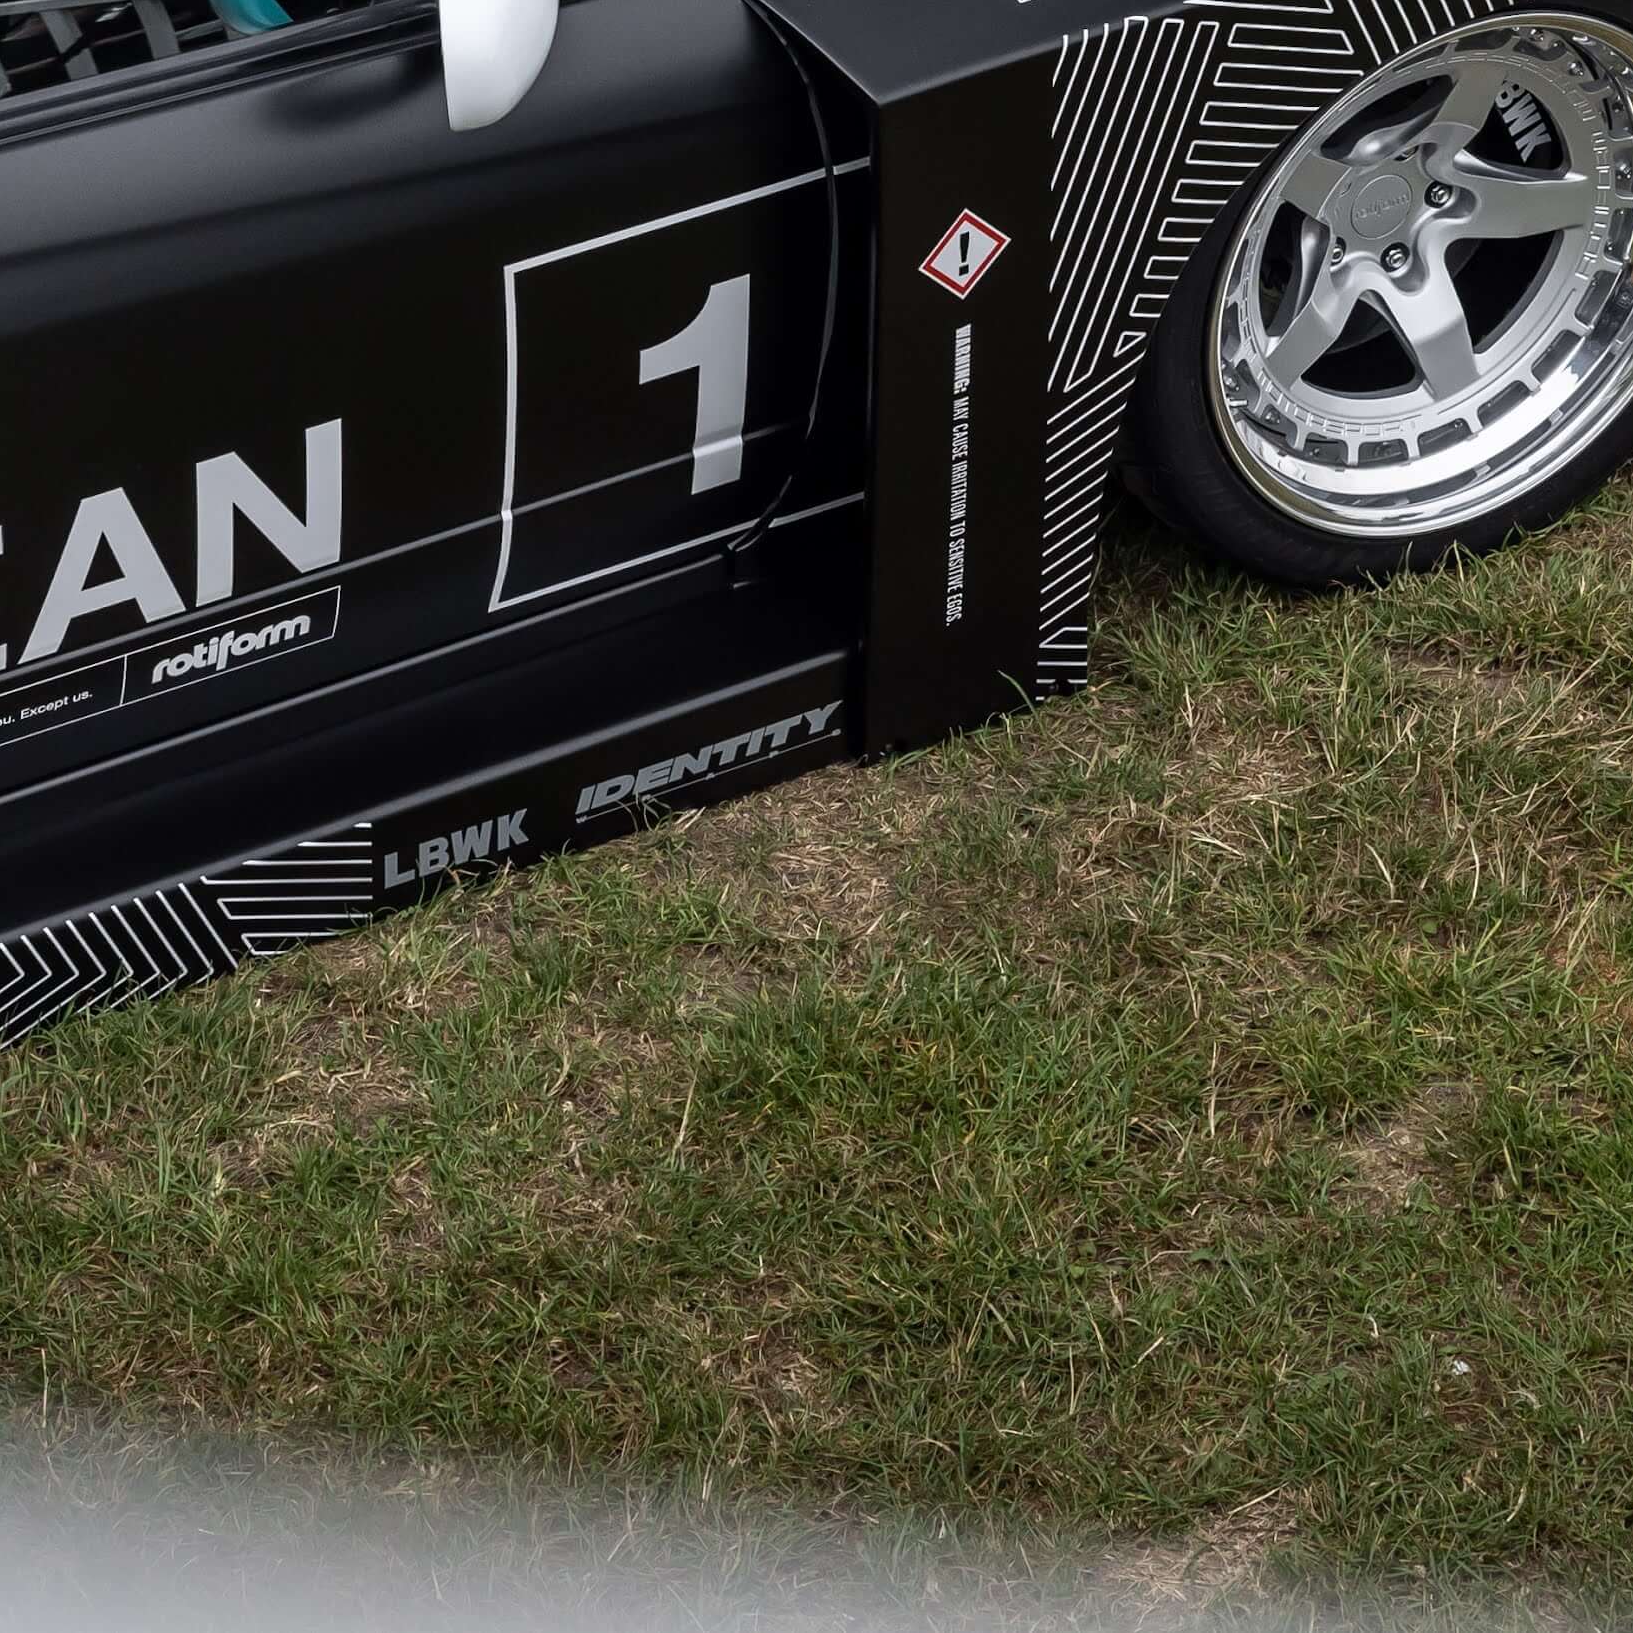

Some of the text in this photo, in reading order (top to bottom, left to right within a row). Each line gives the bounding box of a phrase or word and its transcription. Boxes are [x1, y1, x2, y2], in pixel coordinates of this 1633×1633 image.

[639, 273, 751, 495] 1
[946, 324, 971, 626] WARNING: MAY CAUSE IRRITATION TO SENSITIVE EGOS.
[152, 615, 310, 683] rotiform
[21, 697, 68, 719] Except
[73, 692, 92, 702] us.
[575, 700, 842, 814] IDENTITY
[385, 808, 529, 887] LBWK
